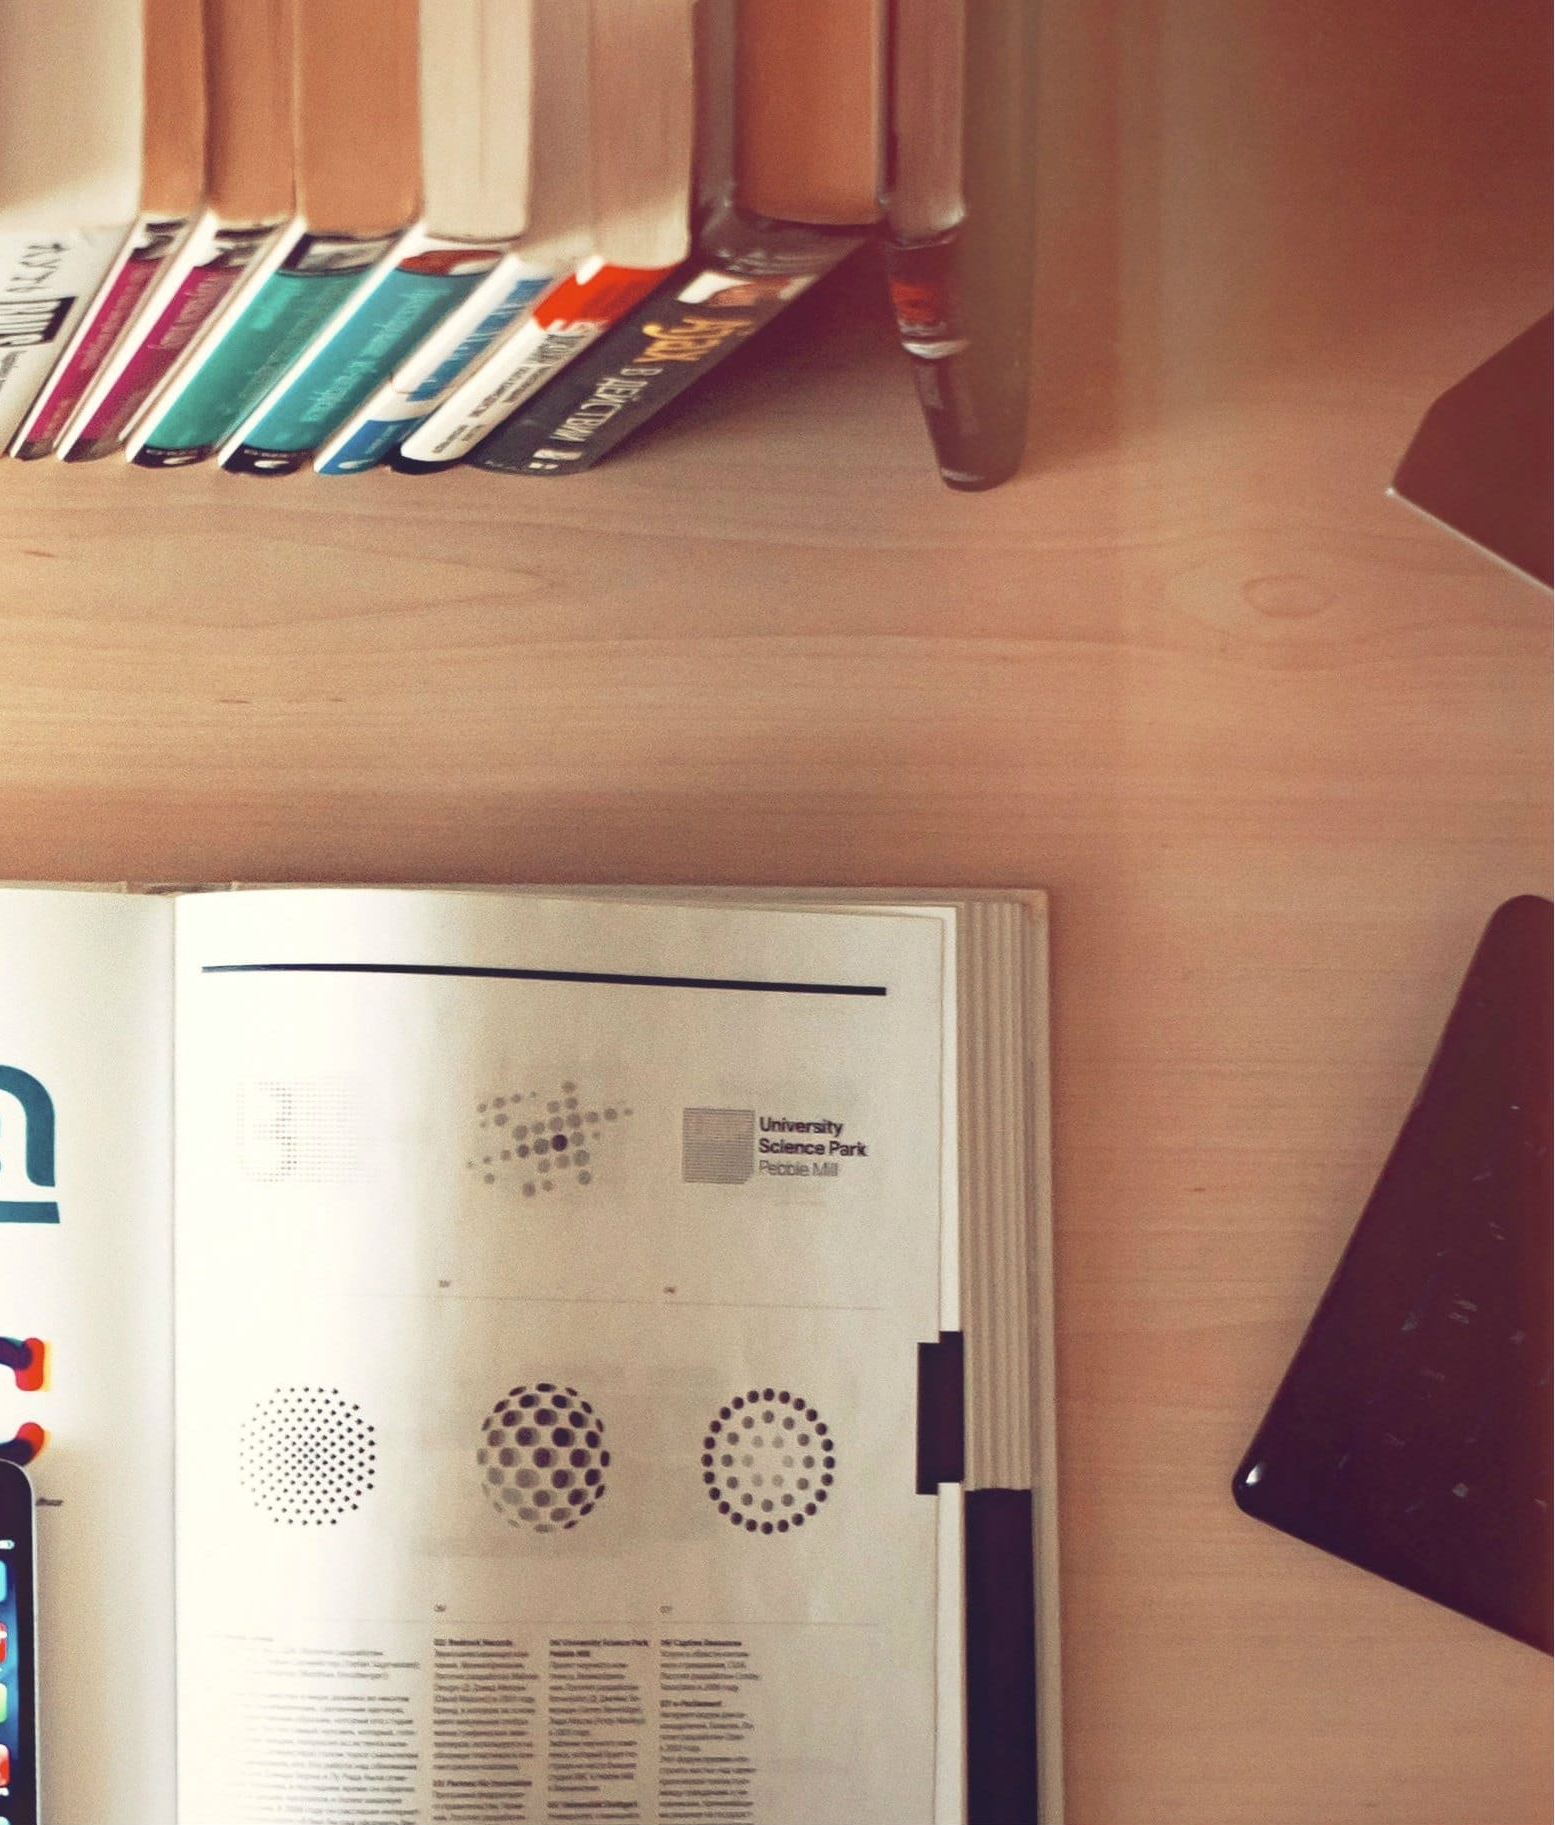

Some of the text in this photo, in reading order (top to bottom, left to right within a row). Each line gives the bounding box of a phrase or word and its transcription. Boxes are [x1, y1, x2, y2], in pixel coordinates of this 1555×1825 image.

[632, 315, 753, 364] Ajax
[549, 377, 649, 443] ДЕЙСТВИИ
[758, 1116, 844, 1138] University
[758, 1138, 869, 1157] Science Park
[812, 1162, 839, 1177] Mill
